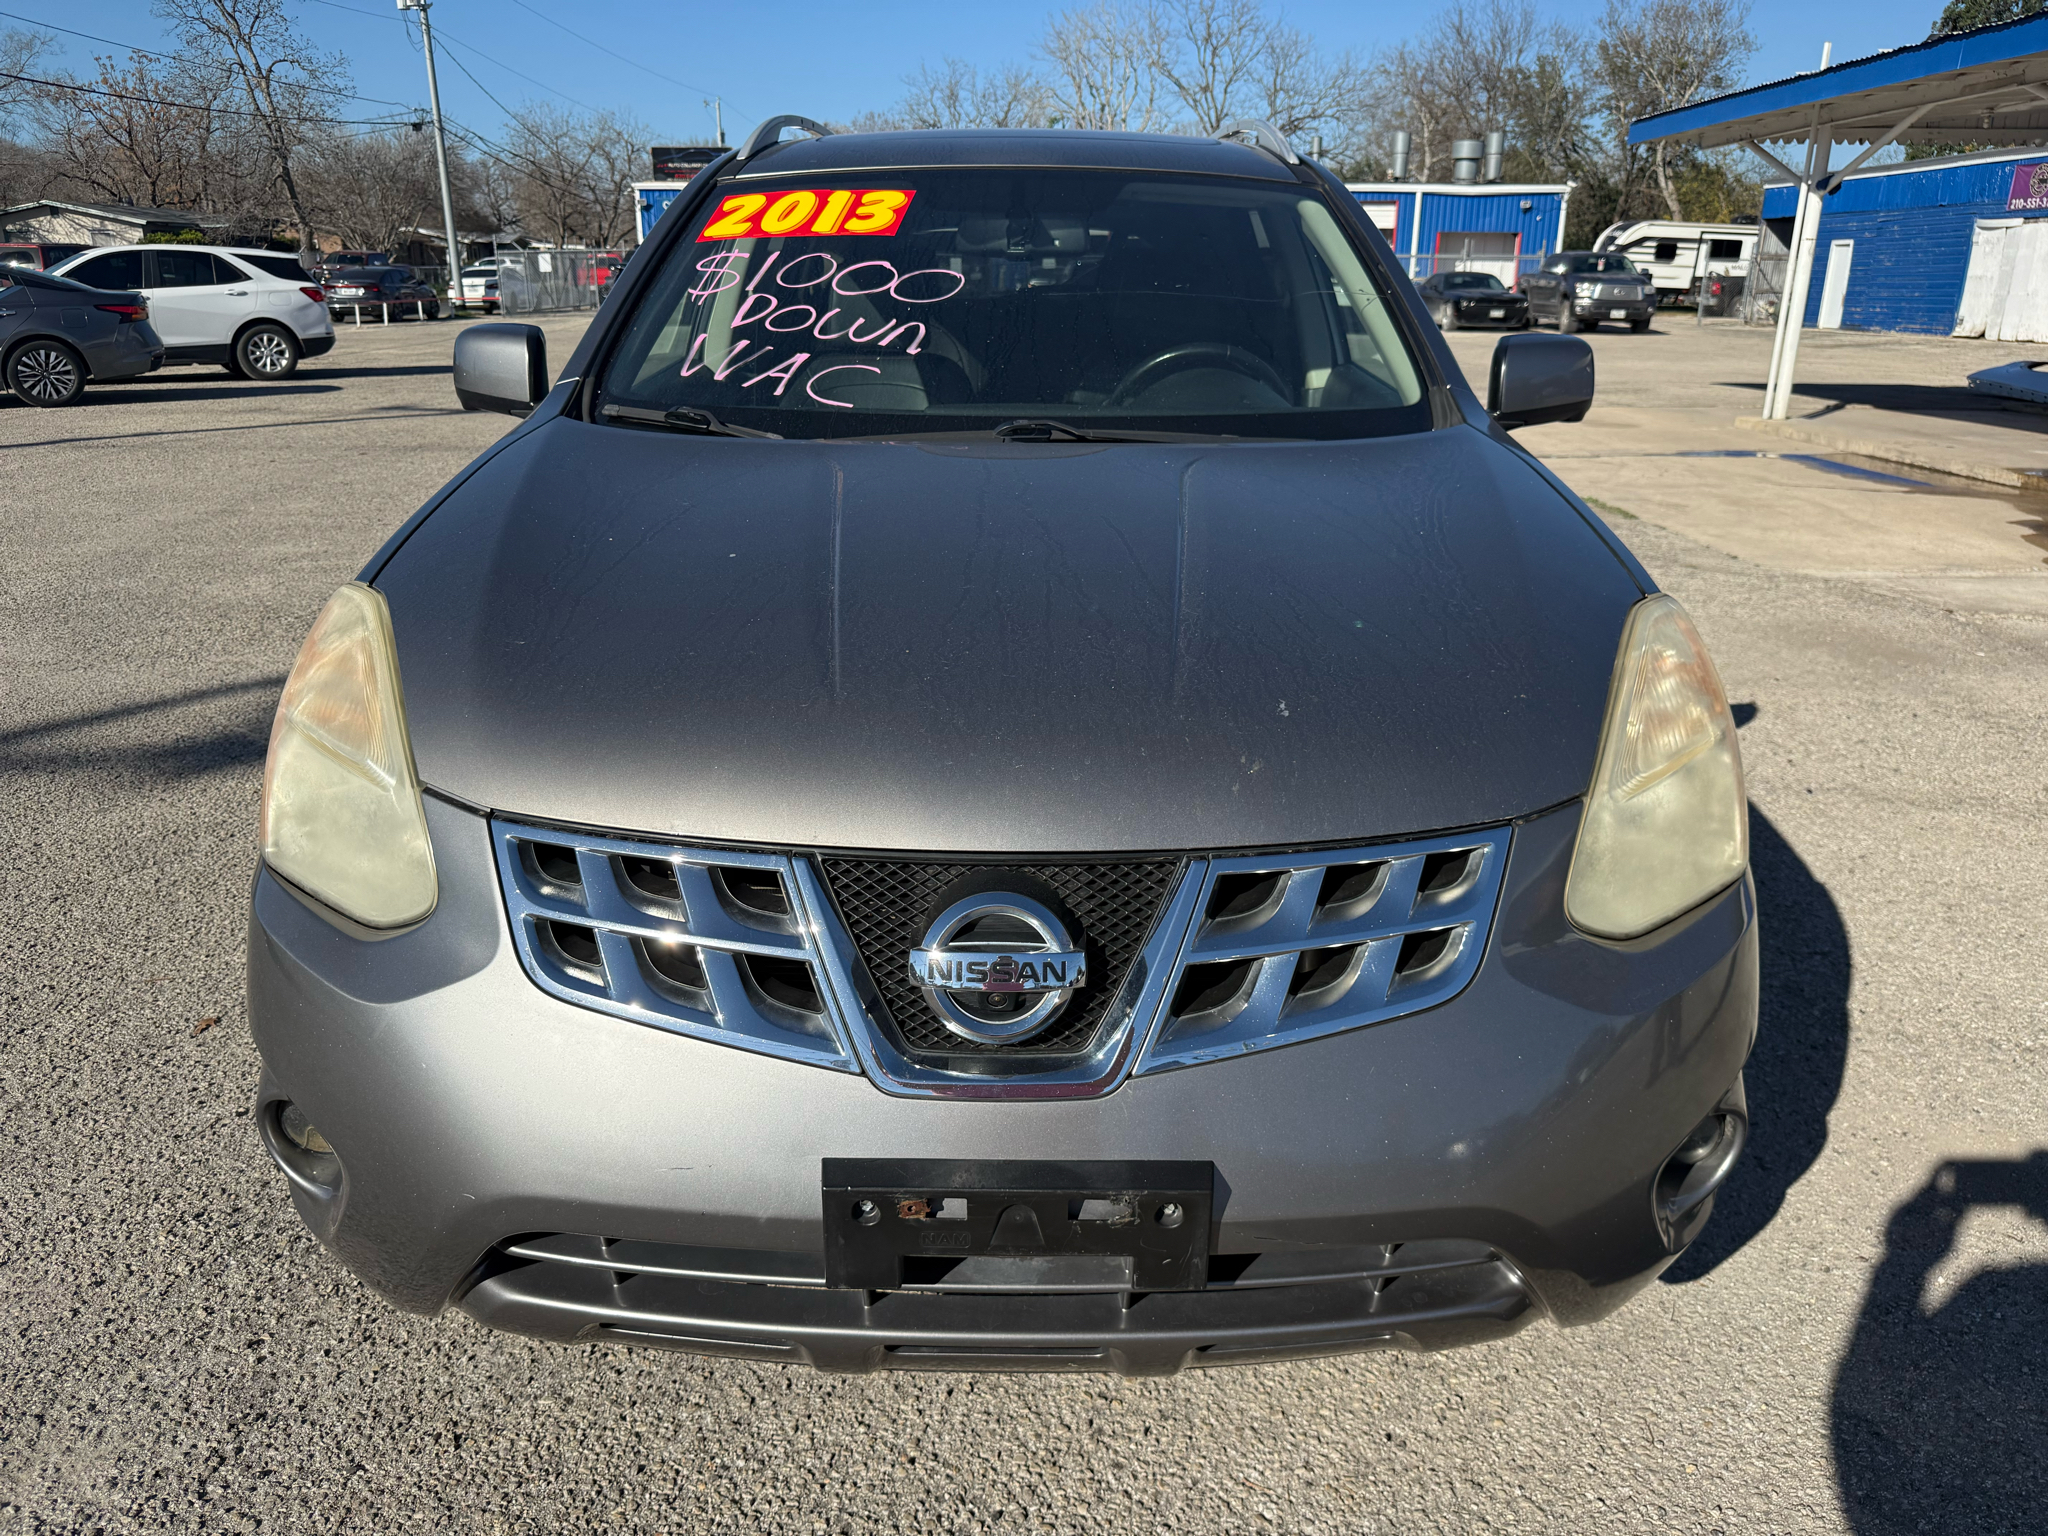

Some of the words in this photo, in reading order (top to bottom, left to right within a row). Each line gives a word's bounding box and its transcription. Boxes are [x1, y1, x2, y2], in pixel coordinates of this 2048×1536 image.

[704, 190, 908, 236] 2013
[688, 249, 965, 305] $1000
[680, 333, 880, 408] WAC
[927, 959, 1067, 983] NISSAN
[921, 1232, 969, 1245] NAM
